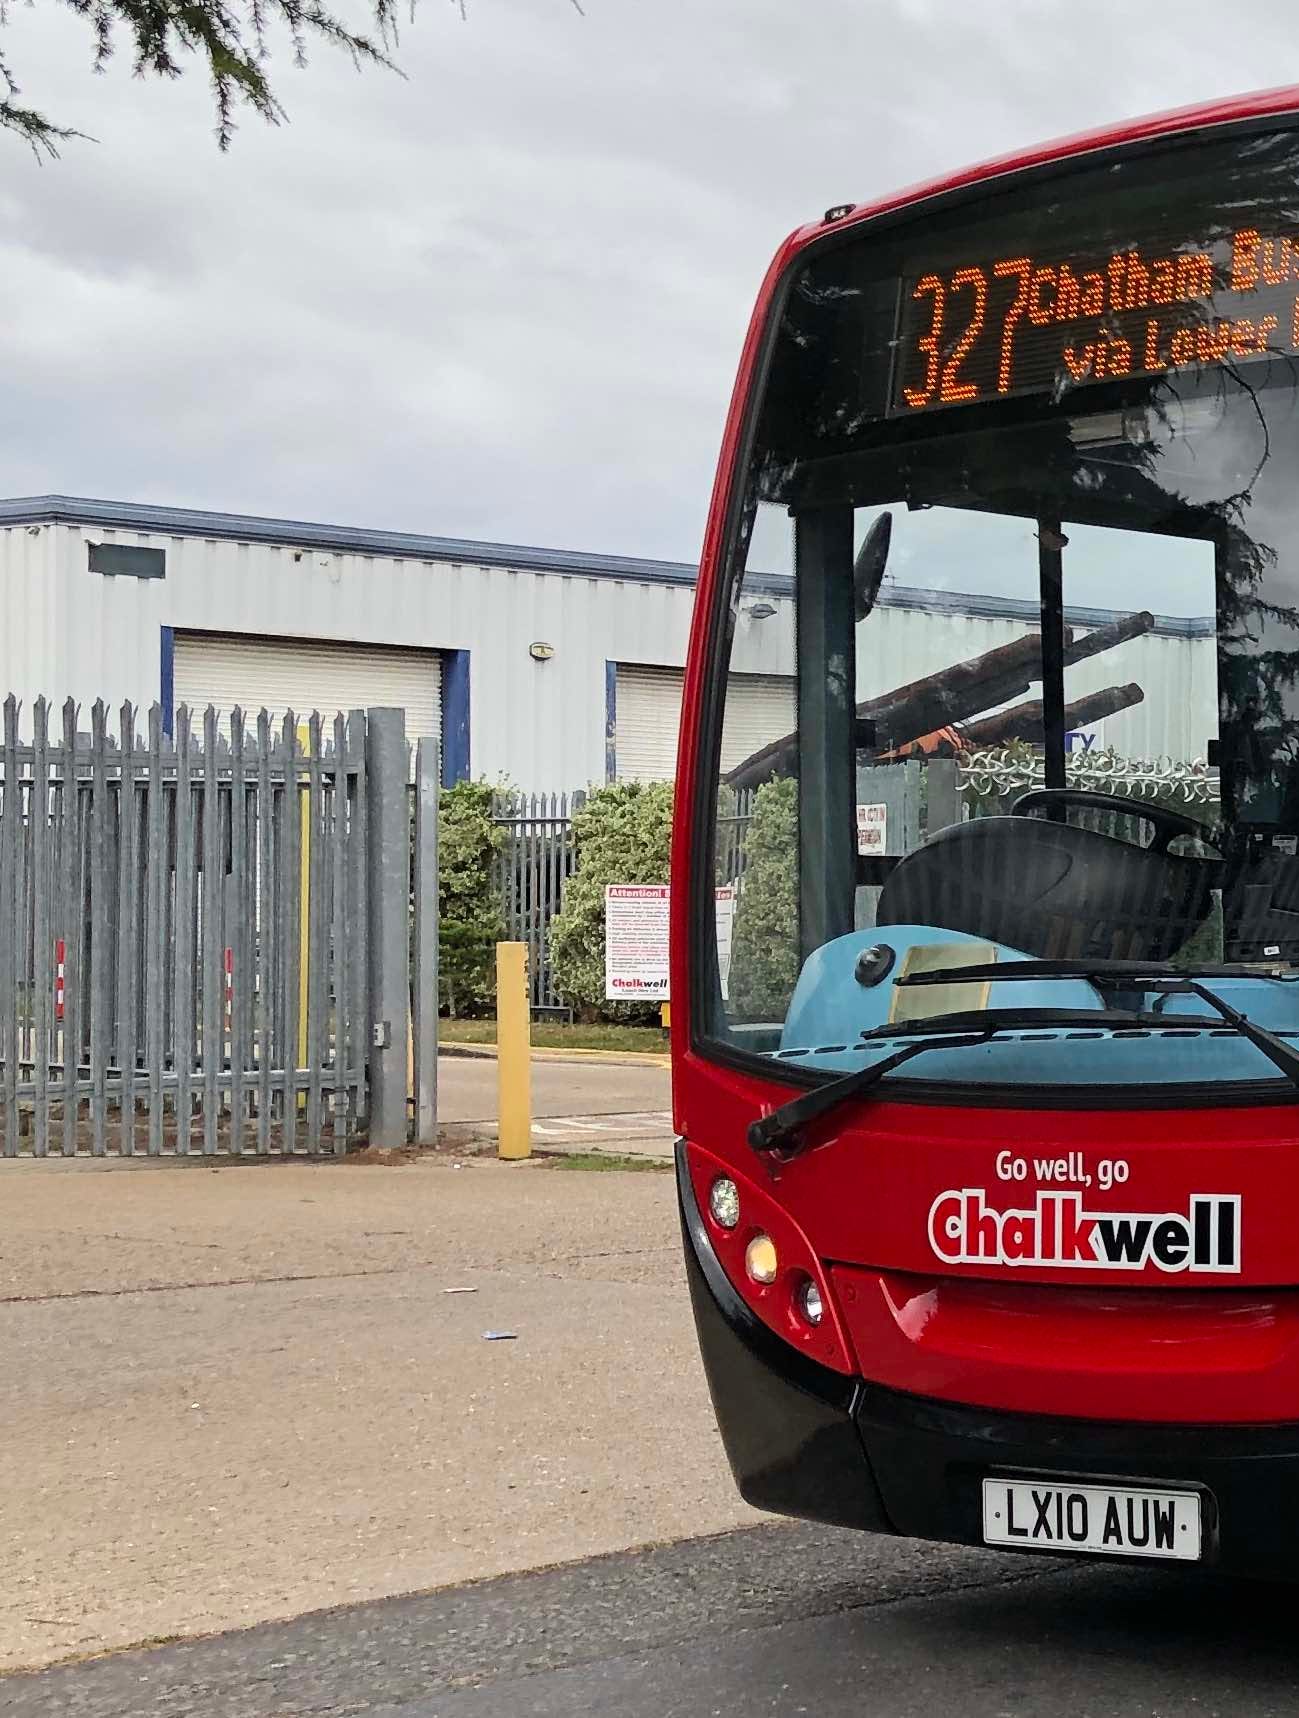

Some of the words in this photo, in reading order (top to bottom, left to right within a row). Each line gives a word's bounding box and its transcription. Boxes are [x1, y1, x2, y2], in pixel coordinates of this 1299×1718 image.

[1028, 249, 1214, 327] Chatham
[903, 257, 1031, 407] 327
[1063, 327, 1132, 381] via
[1144, 314, 1279, 370] Lower
[610, 888, 662, 898] Attention!
[612, 979, 668, 988] Chalkwell
[996, 1150, 1027, 1181] Go
[1033, 1151, 1092, 1187] well,
[1097, 1158, 1130, 1190] go
[928, 1188, 1242, 1273] Chalkwell
[1006, 1488, 1089, 1542] LX10
[1102, 1496, 1176, 1550] AUW
